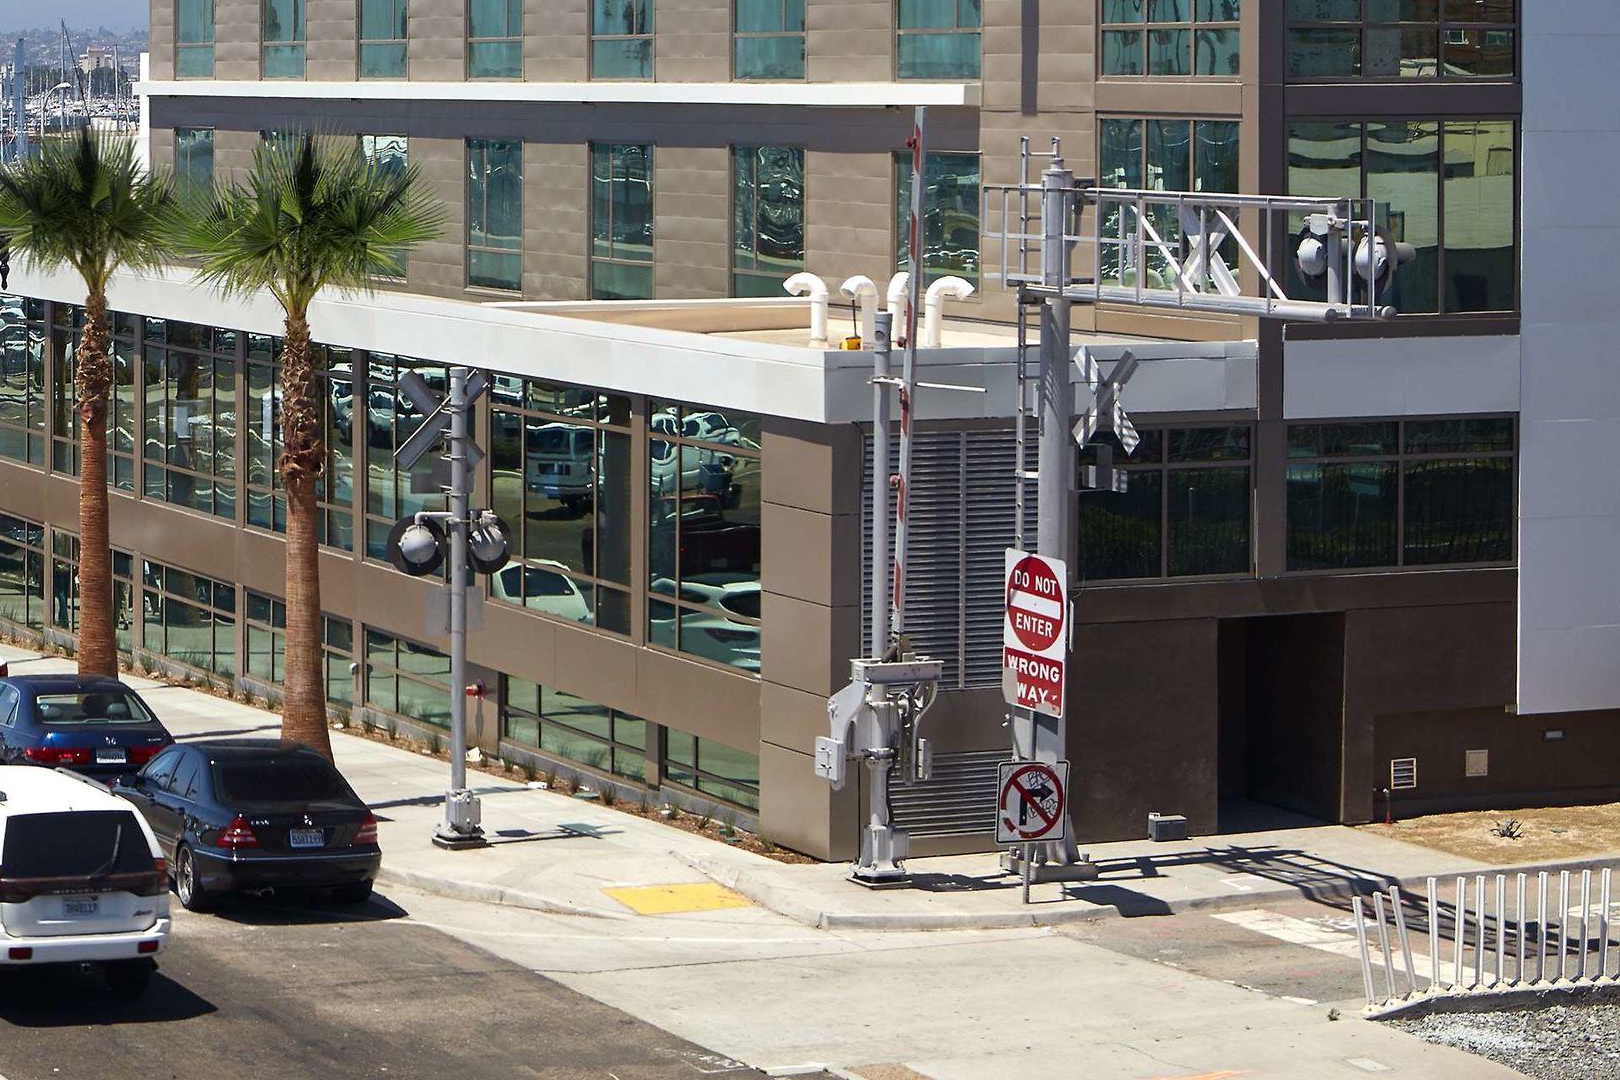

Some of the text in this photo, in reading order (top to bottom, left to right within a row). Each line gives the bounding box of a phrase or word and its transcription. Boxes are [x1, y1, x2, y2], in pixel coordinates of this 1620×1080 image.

[1015, 570, 1057, 596] DO NOT
[1016, 613, 1053, 638] ENTER
[1007, 654, 1060, 683] WRONG
[1017, 681, 1048, 704] WAY
